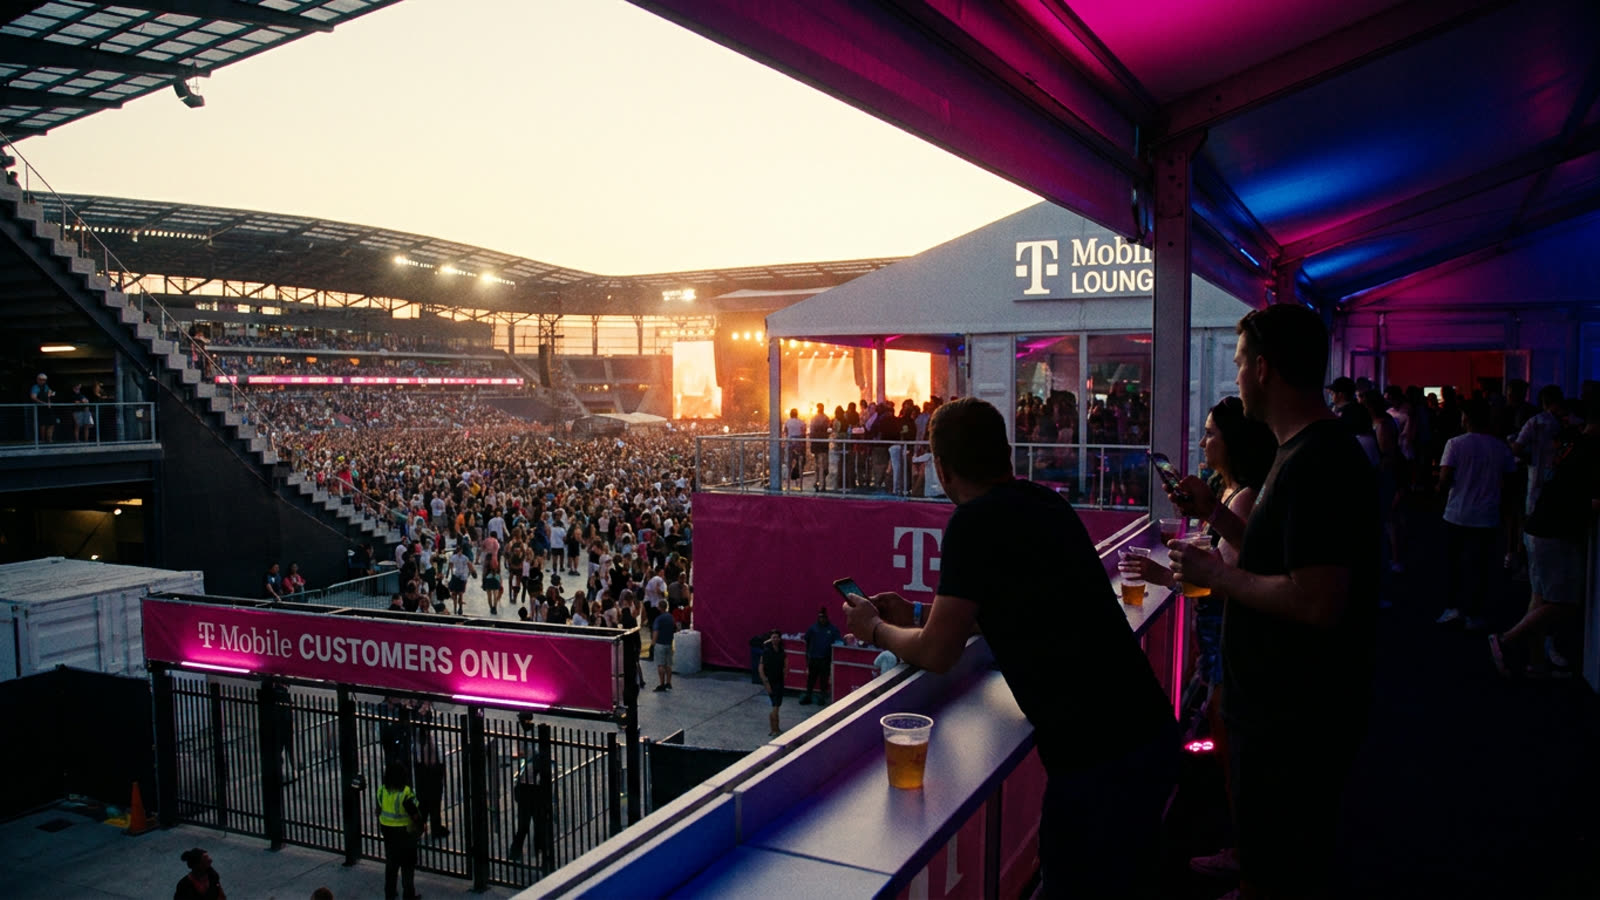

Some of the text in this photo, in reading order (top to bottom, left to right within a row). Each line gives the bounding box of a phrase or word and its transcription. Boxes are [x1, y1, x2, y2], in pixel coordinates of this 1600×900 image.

[1016, 240, 1058, 295] T
[1072, 269, 1154, 294] LOUNG
[198, 621, 533, 682] T Mobile CUSTOMERS ONLY
